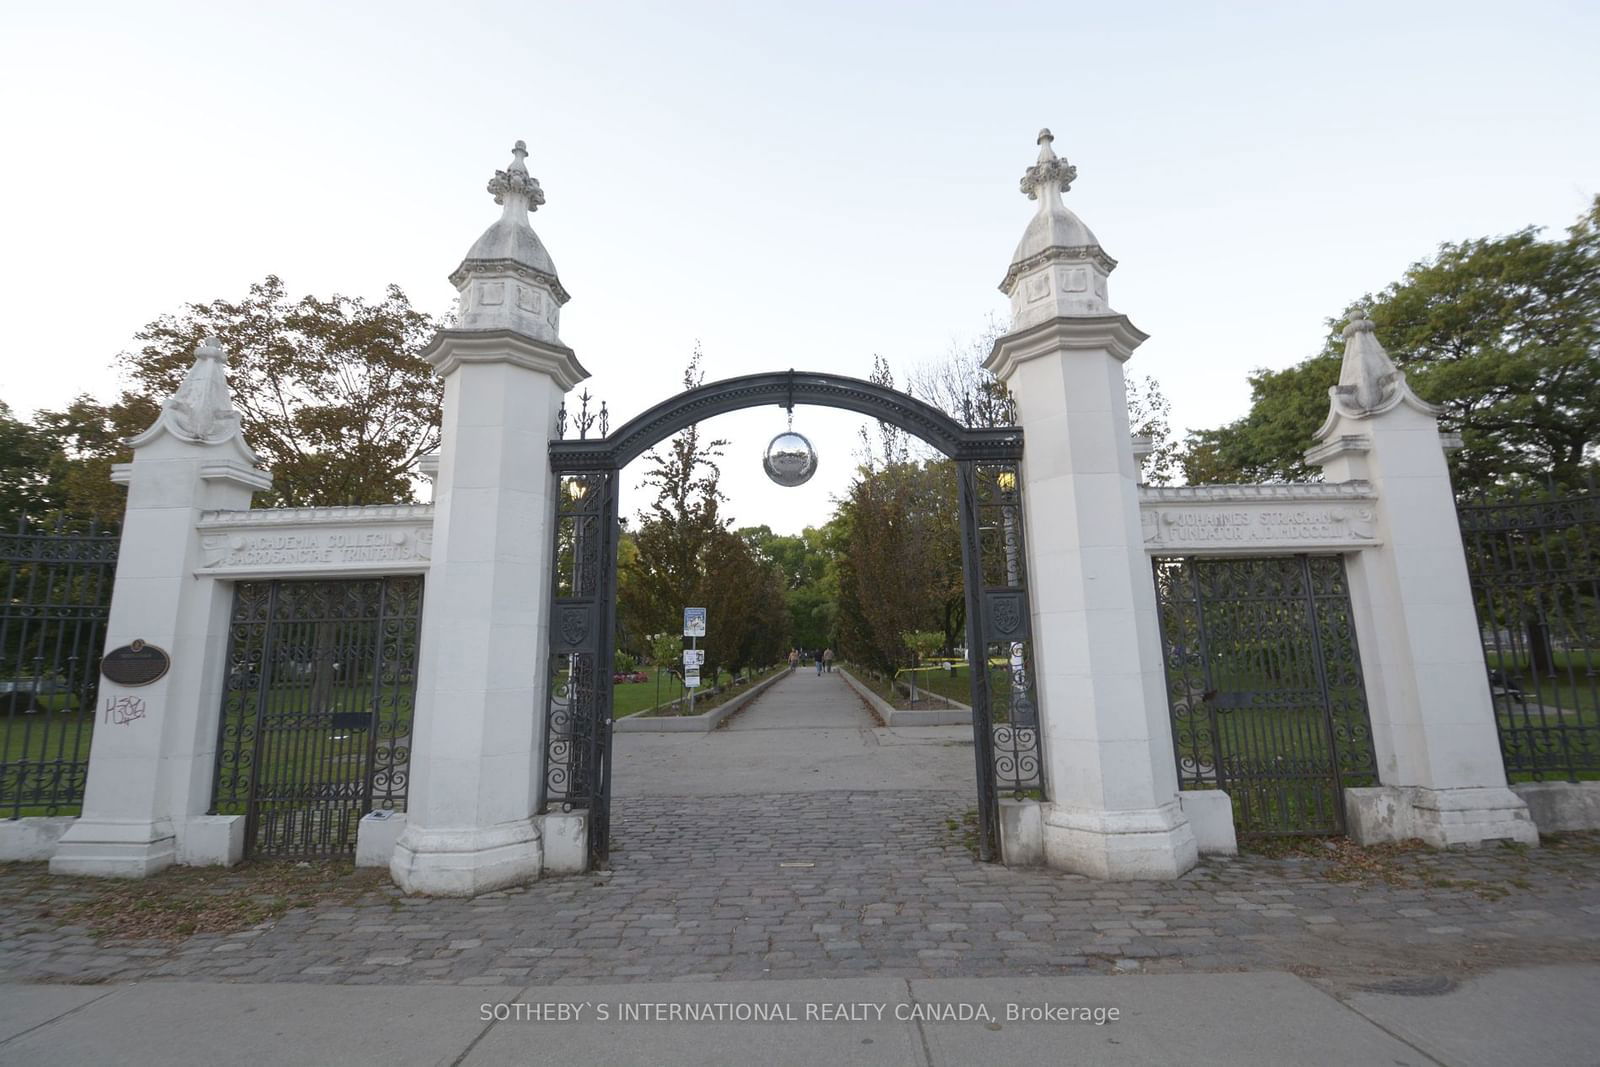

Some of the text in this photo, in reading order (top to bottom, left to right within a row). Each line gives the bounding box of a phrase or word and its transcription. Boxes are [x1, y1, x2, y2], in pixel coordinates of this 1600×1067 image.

[1176, 510, 1331, 528] JOHANNES STRACHAN
[250, 532, 393, 551] ACADEMIA COLLEGII
[1169, 526, 1243, 542] FUNDATOR
[228, 547, 410, 566] SACROSANCTAE TRINITATIS
